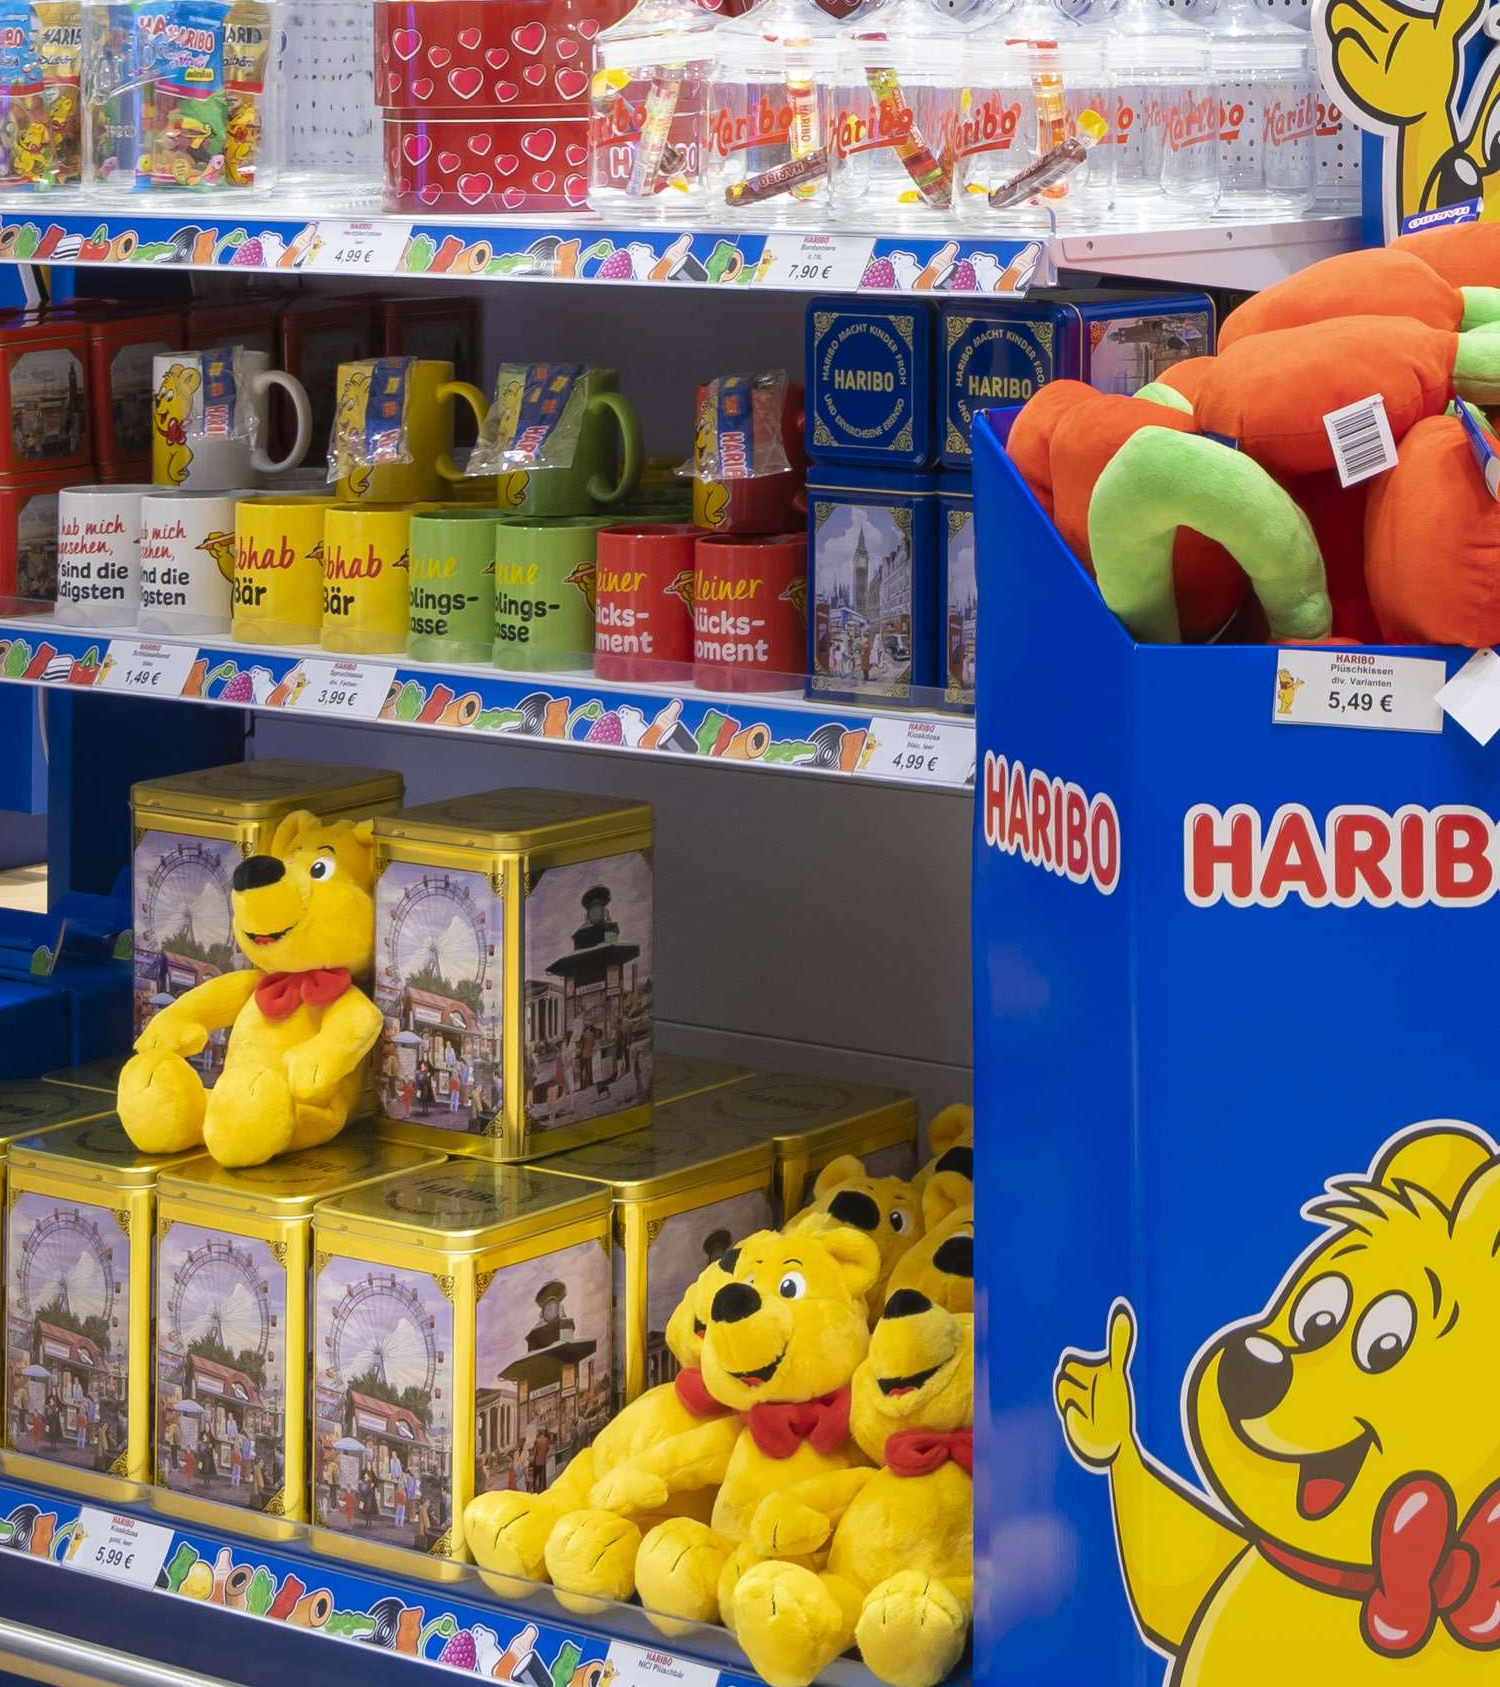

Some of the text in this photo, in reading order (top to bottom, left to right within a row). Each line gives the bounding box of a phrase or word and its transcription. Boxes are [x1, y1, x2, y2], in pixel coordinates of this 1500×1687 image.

[710, 94, 794, 157] Haribo
[830, 99, 913, 159] Haribo
[334, 249, 375, 263] 4,99 €
[788, 264, 833, 280] 7,90 €
[822, 323, 907, 386] HARIBO MACHT KINDER FROH
[956, 345, 973, 386] HARIBO
[974, 329, 1004, 348] MACHT
[1006, 330, 1036, 360] KINDER
[834, 369, 894, 393] HARIBO
[969, 375, 1032, 400] HARIBO
[824, 393, 838, 417] UND
[85, 514, 126, 535] mich
[151, 520, 187, 540] mich
[61, 561, 129, 579] sind die
[160, 568, 190, 585] die
[60, 580, 125, 603] digsten
[1330, 663, 1394, 676] Plüschkissen
[1336, 654, 1376, 665] HARIBO
[125, 670, 162, 685] 1,49 €
[1349, 678, 1392, 688] Varianten
[318, 689, 358, 706] 3,99 €
[1328, 691, 1394, 712] 5,49 €
[892, 753, 939, 772] 4,99 €
[985, 752, 1118, 892] HARIBO
[95, 1546, 135, 1569] 5,99 €
[645, 1652, 674, 1666] HARIBO
